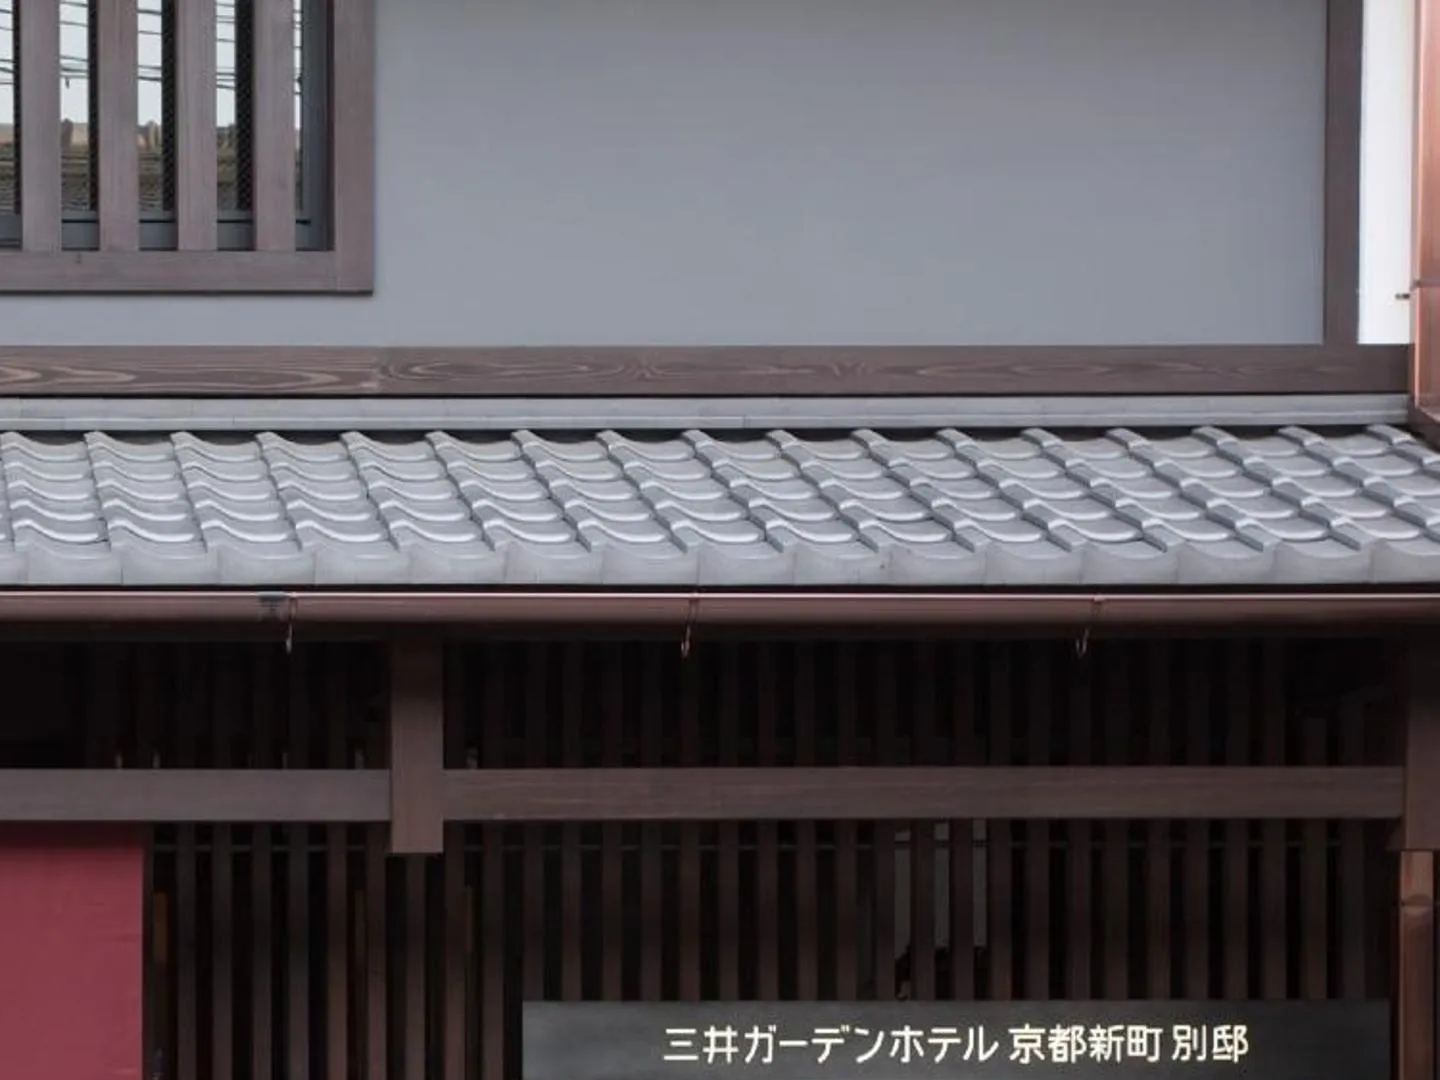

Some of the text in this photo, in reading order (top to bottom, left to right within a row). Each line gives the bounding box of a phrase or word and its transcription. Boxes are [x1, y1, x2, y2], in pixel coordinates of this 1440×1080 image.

[662, 1022, 1250, 1065] 三井ガーデンホテル 京都新町 別邸
